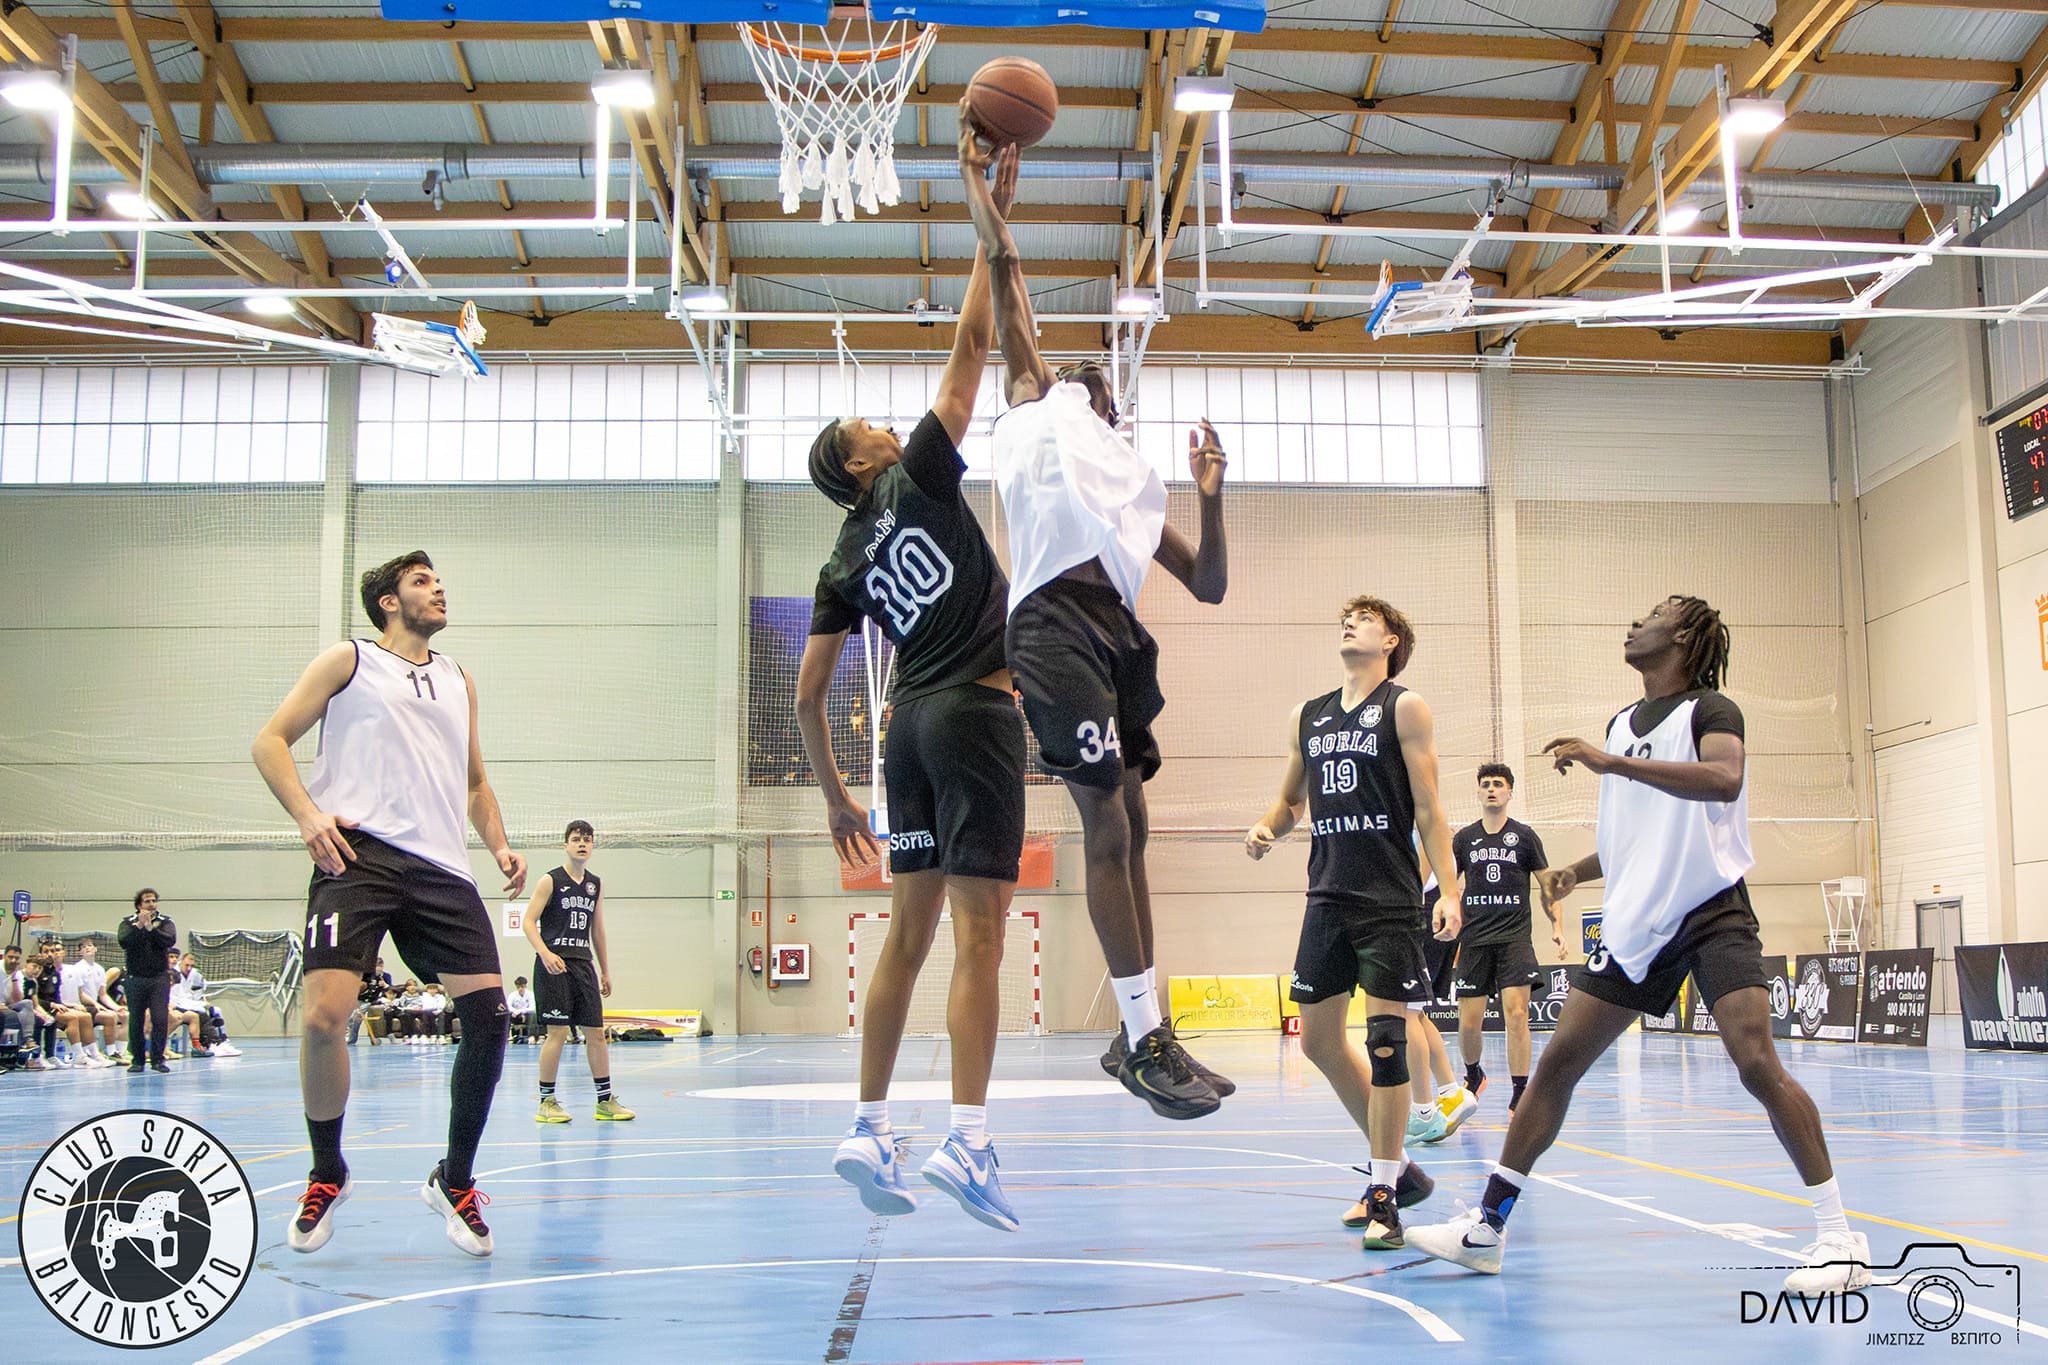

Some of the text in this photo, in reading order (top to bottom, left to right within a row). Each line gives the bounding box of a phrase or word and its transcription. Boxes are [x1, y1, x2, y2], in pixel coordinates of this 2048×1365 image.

[2024, 438, 2041, 453] LOCAL
[2030, 451, 2045, 469] 47
[865, 527, 954, 636] 10
[407, 670, 436, 701] 11
[1076, 716, 1121, 763] 34
[1308, 731, 1378, 758] SORIA
[1321, 758, 1358, 795] 19
[890, 833, 935, 851] Soria
[1469, 847, 1517, 864] SORIA
[1486, 863, 1501, 883] 8
[561, 896, 595, 913] SORIA
[1466, 894, 1520, 906] DECIMAS
[307, 911, 340, 949] 11
[569, 910, 588, 930] 13
[1878, 964, 1926, 994] atiendo
[2016, 986, 2046, 1017] adolfo
